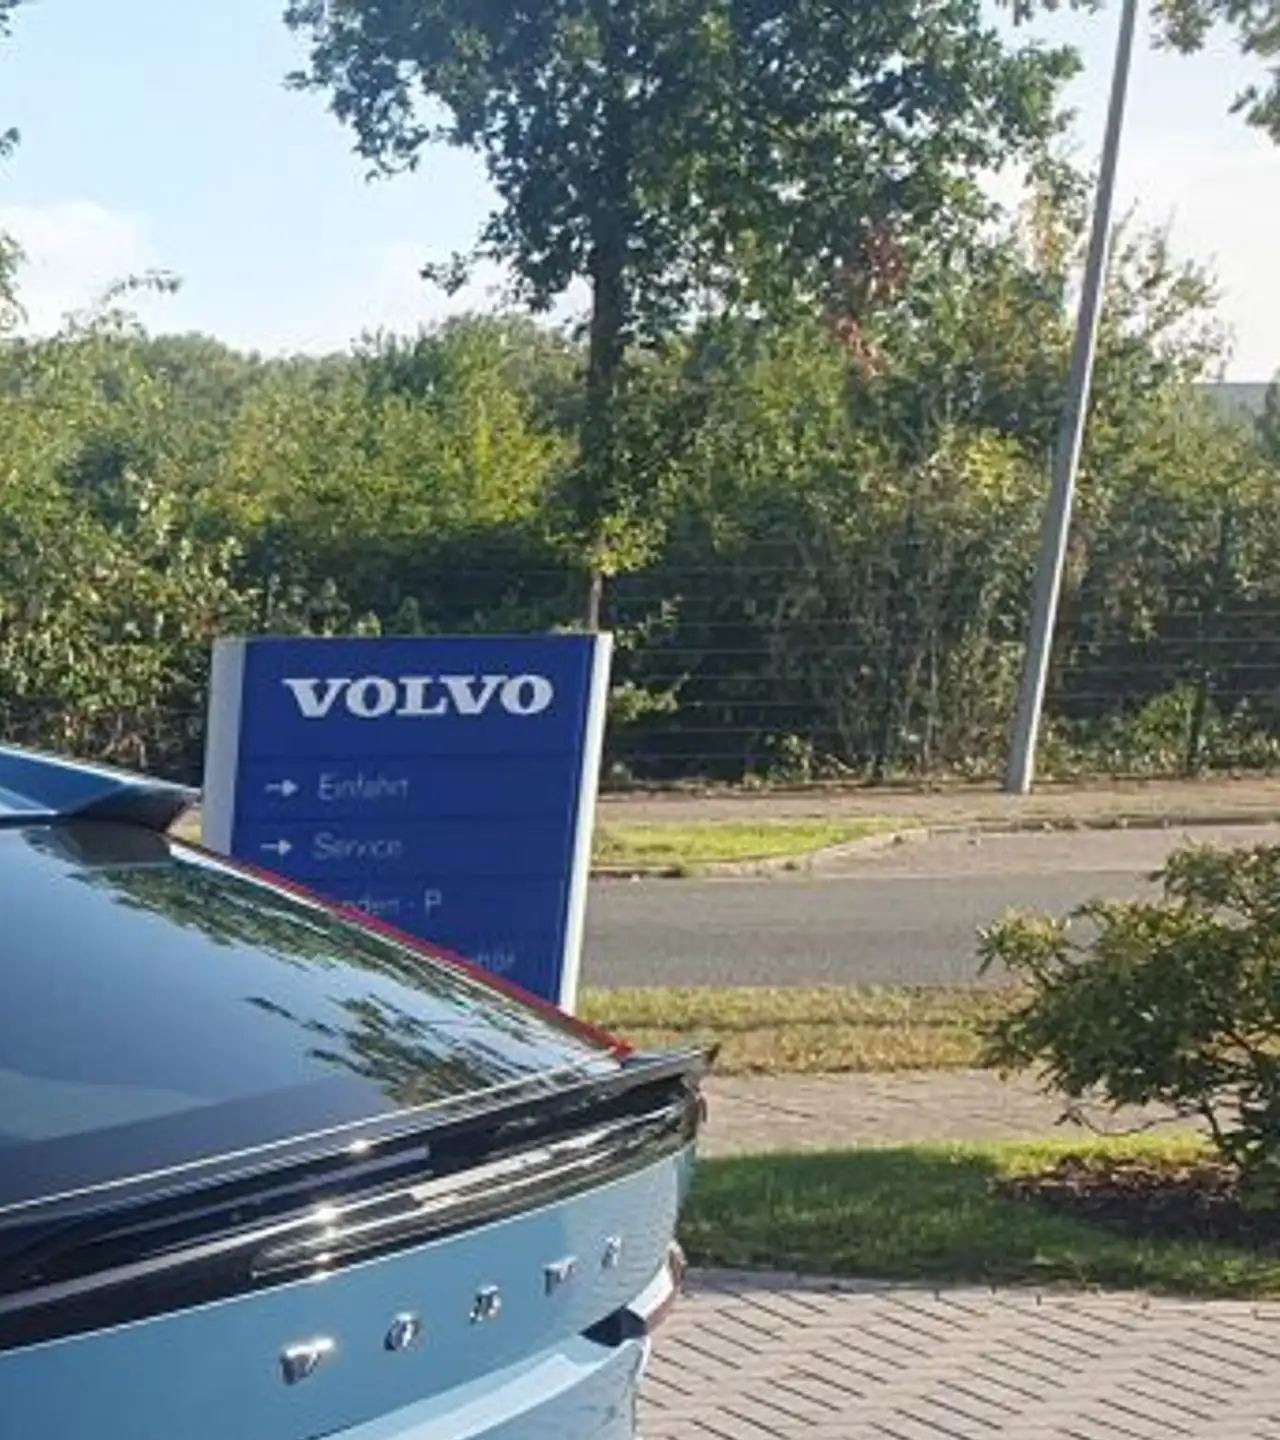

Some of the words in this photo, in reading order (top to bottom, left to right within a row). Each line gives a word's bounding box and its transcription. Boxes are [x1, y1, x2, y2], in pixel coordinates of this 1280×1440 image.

[283, 674, 554, 718] VOLVO
[318, 771, 408, 800] Einfahrt
[313, 831, 403, 861] Service
